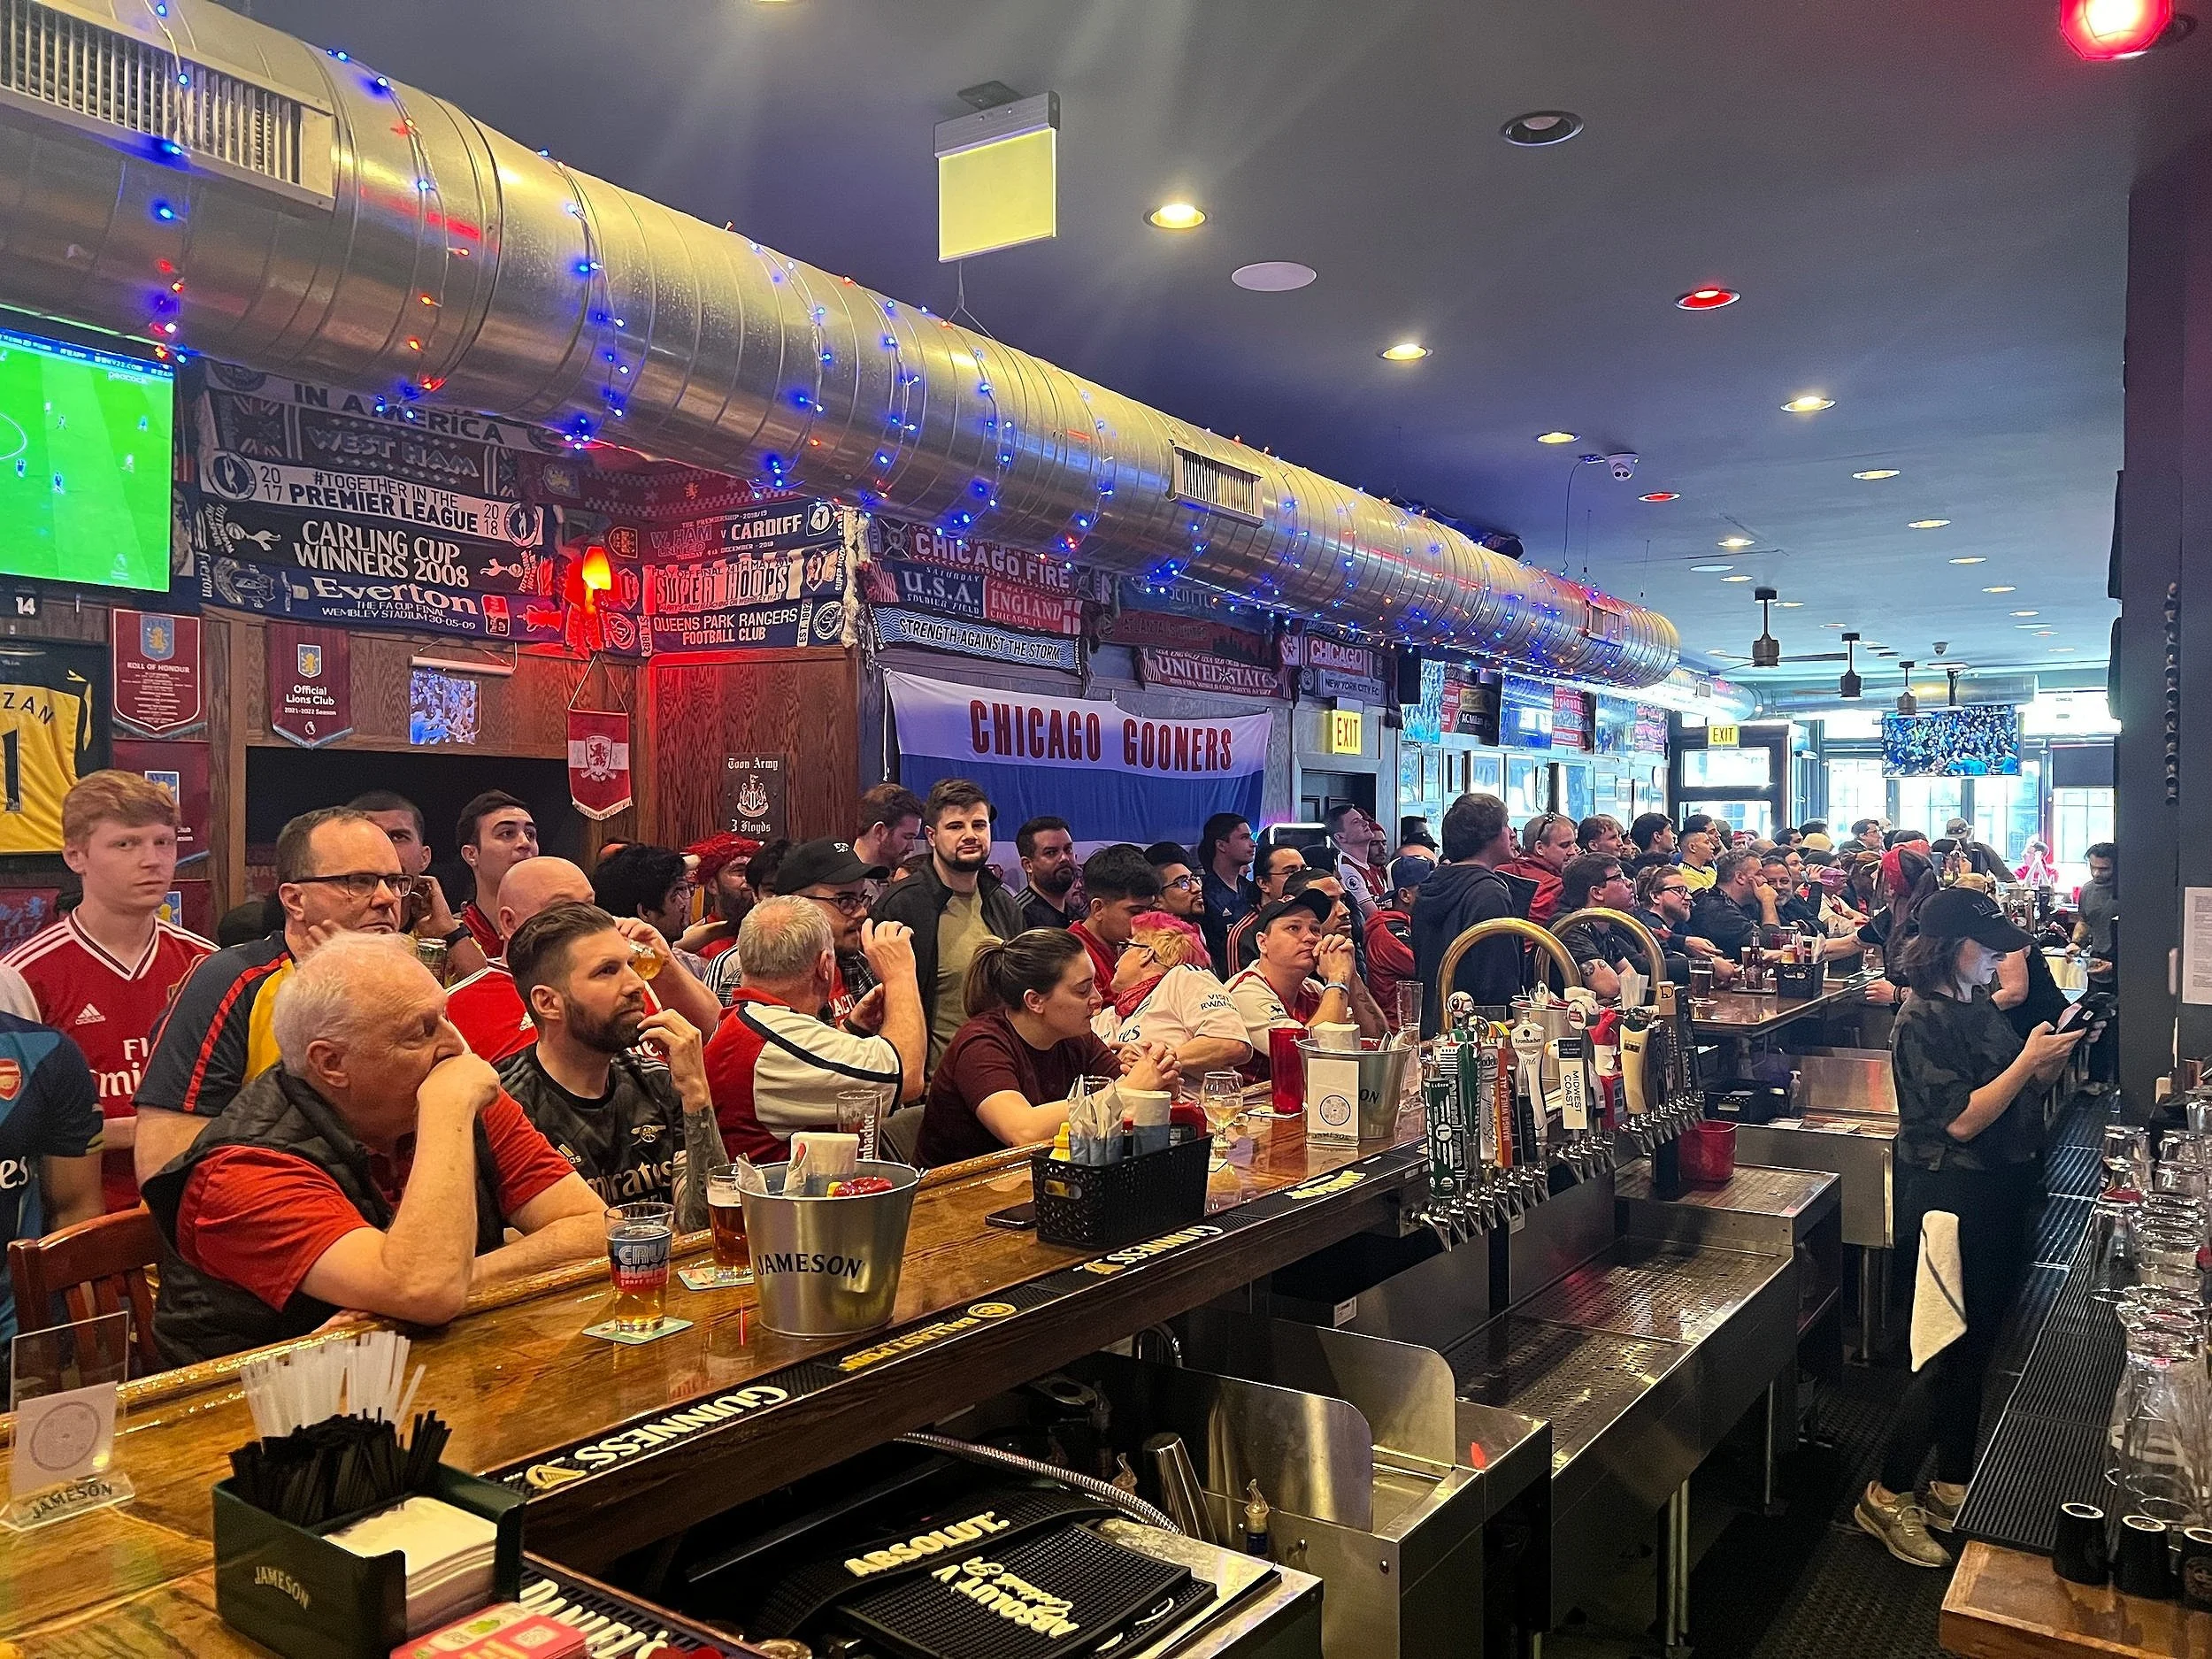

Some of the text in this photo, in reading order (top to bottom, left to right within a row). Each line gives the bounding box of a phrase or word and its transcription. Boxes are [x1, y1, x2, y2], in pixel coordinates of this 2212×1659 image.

[294, 383, 328, 408] IN
[307, 426, 480, 478] WEST HAM
[260, 466, 281, 484] 20
[265, 484, 282, 502] 17
[314, 472, 458, 509] #TOGETHER IN THE
[288, 484, 478, 533] PREMIER LEAGUE
[484, 503, 499, 519] 20
[484, 520, 498, 536] 18
[673, 525, 712, 546] HAM
[731, 514, 803, 541] CARDIFF
[302, 520, 460, 565] CARLING CUP
[293, 541, 470, 588] WINNERS 2008
[696, 567, 723, 576] FINAL
[752, 559, 772, 569] MAY
[915, 533, 1069, 588] CHICAGO FIRE
[926, 567, 980, 582] SATURDAY
[657, 567, 787, 606] SUPER HOOPS
[902, 570, 979, 604] U.S.A.
[1008, 575, 1026, 585] PARK
[15, 596, 36, 615] 14
[311, 576, 480, 615] Everton
[357, 601, 446, 618] THE FA CUP FINAL
[907, 594, 979, 614] SOLDIER FIELD
[990, 588, 1062, 620] ENGLAND
[322, 607, 476, 630] WEMBLEY STADIUM 30-05-09
[653, 608, 798, 631] QUEENS PARK RANGERS
[683, 626, 766, 645] FOOTBALL CLUB
[899, 618, 1061, 660] STRENGTH AGAINST THE STORM
[1310, 639, 1363, 667] CHICAGO
[127, 662, 145, 671] ROLL
[158, 664, 190, 673] HONOUR
[1156, 654, 1221, 683] UNITED
[1227, 667, 1278, 688] STATES
[293, 684, 326, 695] Official
[1325, 678, 1339, 687] NEW
[1340, 680, 1357, 690] YORK
[286, 694, 334, 705] Lions Club
[970, 699, 1233, 772] CHICAGO GOONERS
[1337, 717, 1358, 748] EXIT
[1713, 727, 1734, 742] EXIT
[727, 757, 779, 771] Toon Army
[741, 820, 771, 833] Floyds
[1207, 994, 1231, 1003] VISIT
[1563, 1075, 1573, 1107] COAST
[1572, 1070, 1582, 1113] MIDWEST
[857, 1113, 875, 1160] mbacher
[1502, 1116, 1511, 1141] MANGO
[588, 1160, 673, 1202] mirates
[618, 1245, 666, 1265] CRU
[1106, 1225, 1224, 1265] GUINNESS
[757, 1253, 863, 1279] JAMESON
[895, 1317, 981, 1351] BALLAST
[574, 1386, 788, 1468] GUINNESS
[33, 1479, 113, 1520] JAMESON
[255, 1565, 310, 1610] JAMESON
[951, 1576, 1079, 1639] ABSOLUT
